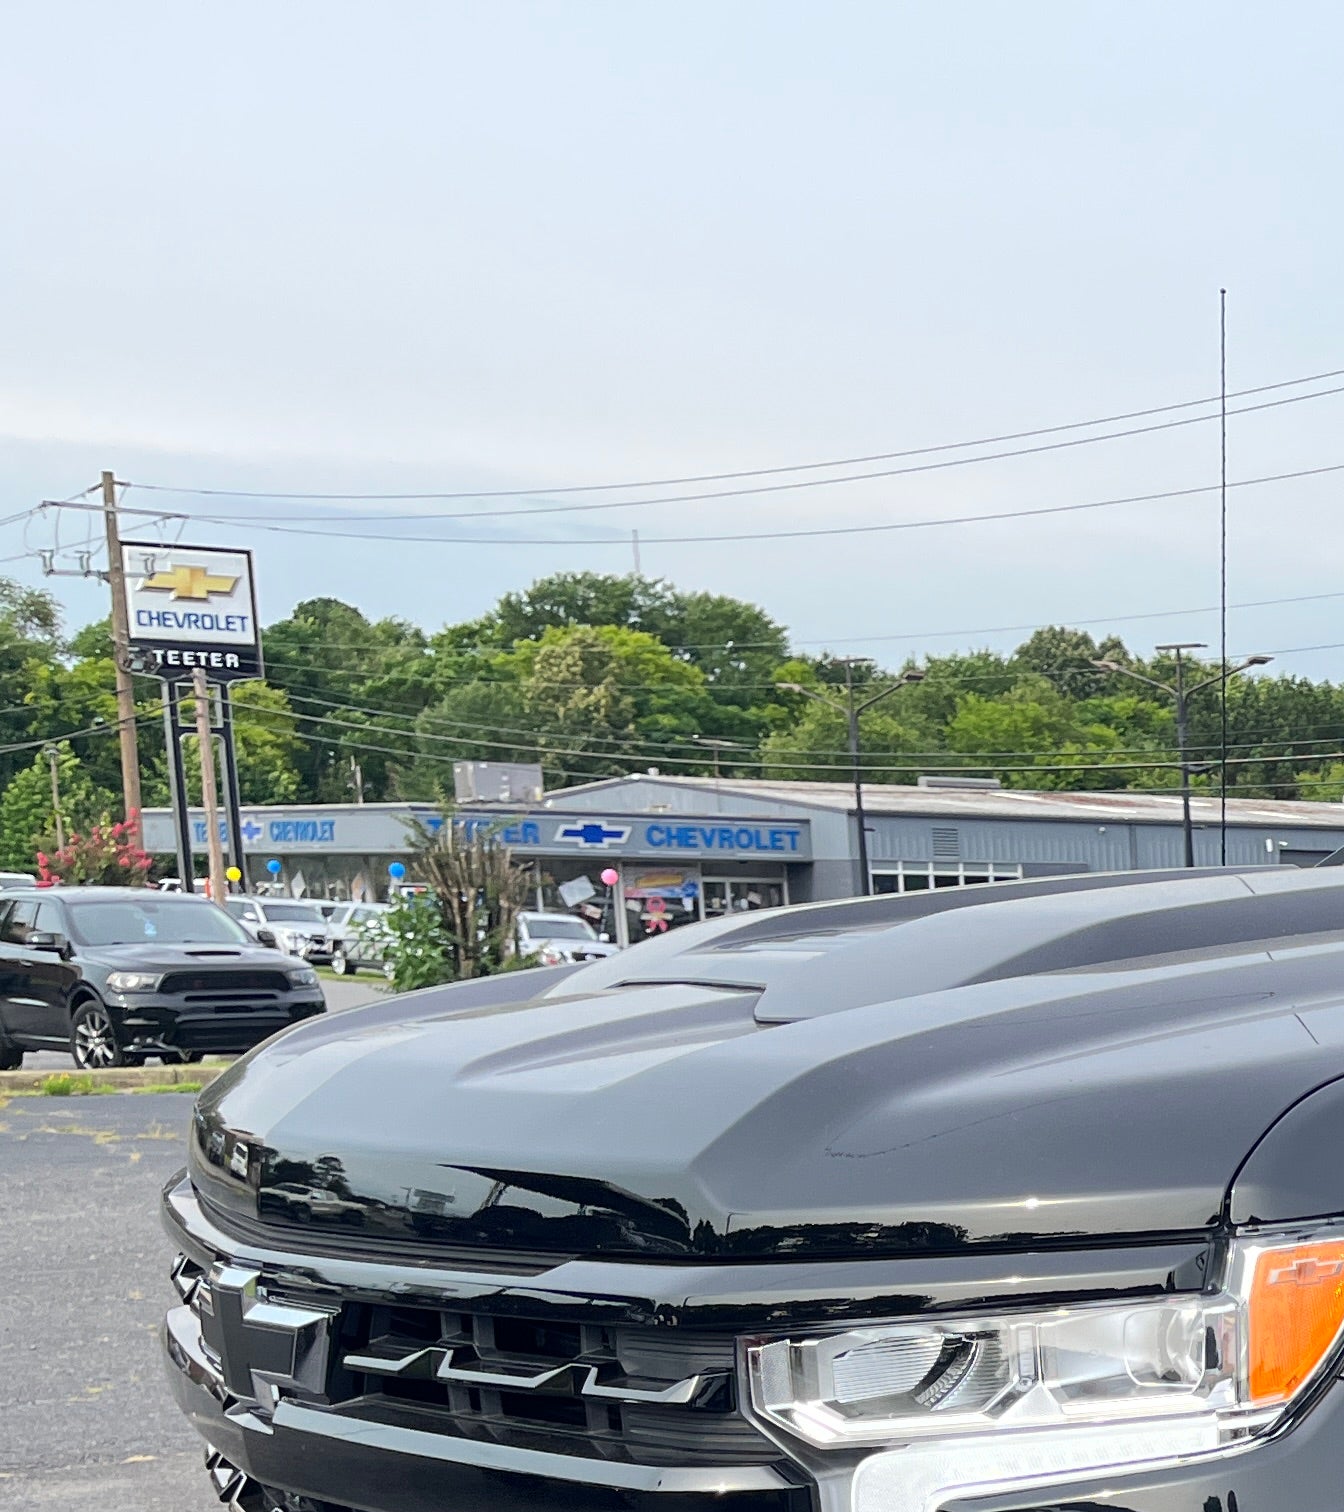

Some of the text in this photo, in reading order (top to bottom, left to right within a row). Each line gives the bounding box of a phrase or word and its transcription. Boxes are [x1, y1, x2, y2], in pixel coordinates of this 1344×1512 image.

[137, 610, 248, 632] CHEVROLET
[153, 650, 239, 668] TEETER
[645, 824, 799, 851] CHEVROLET
